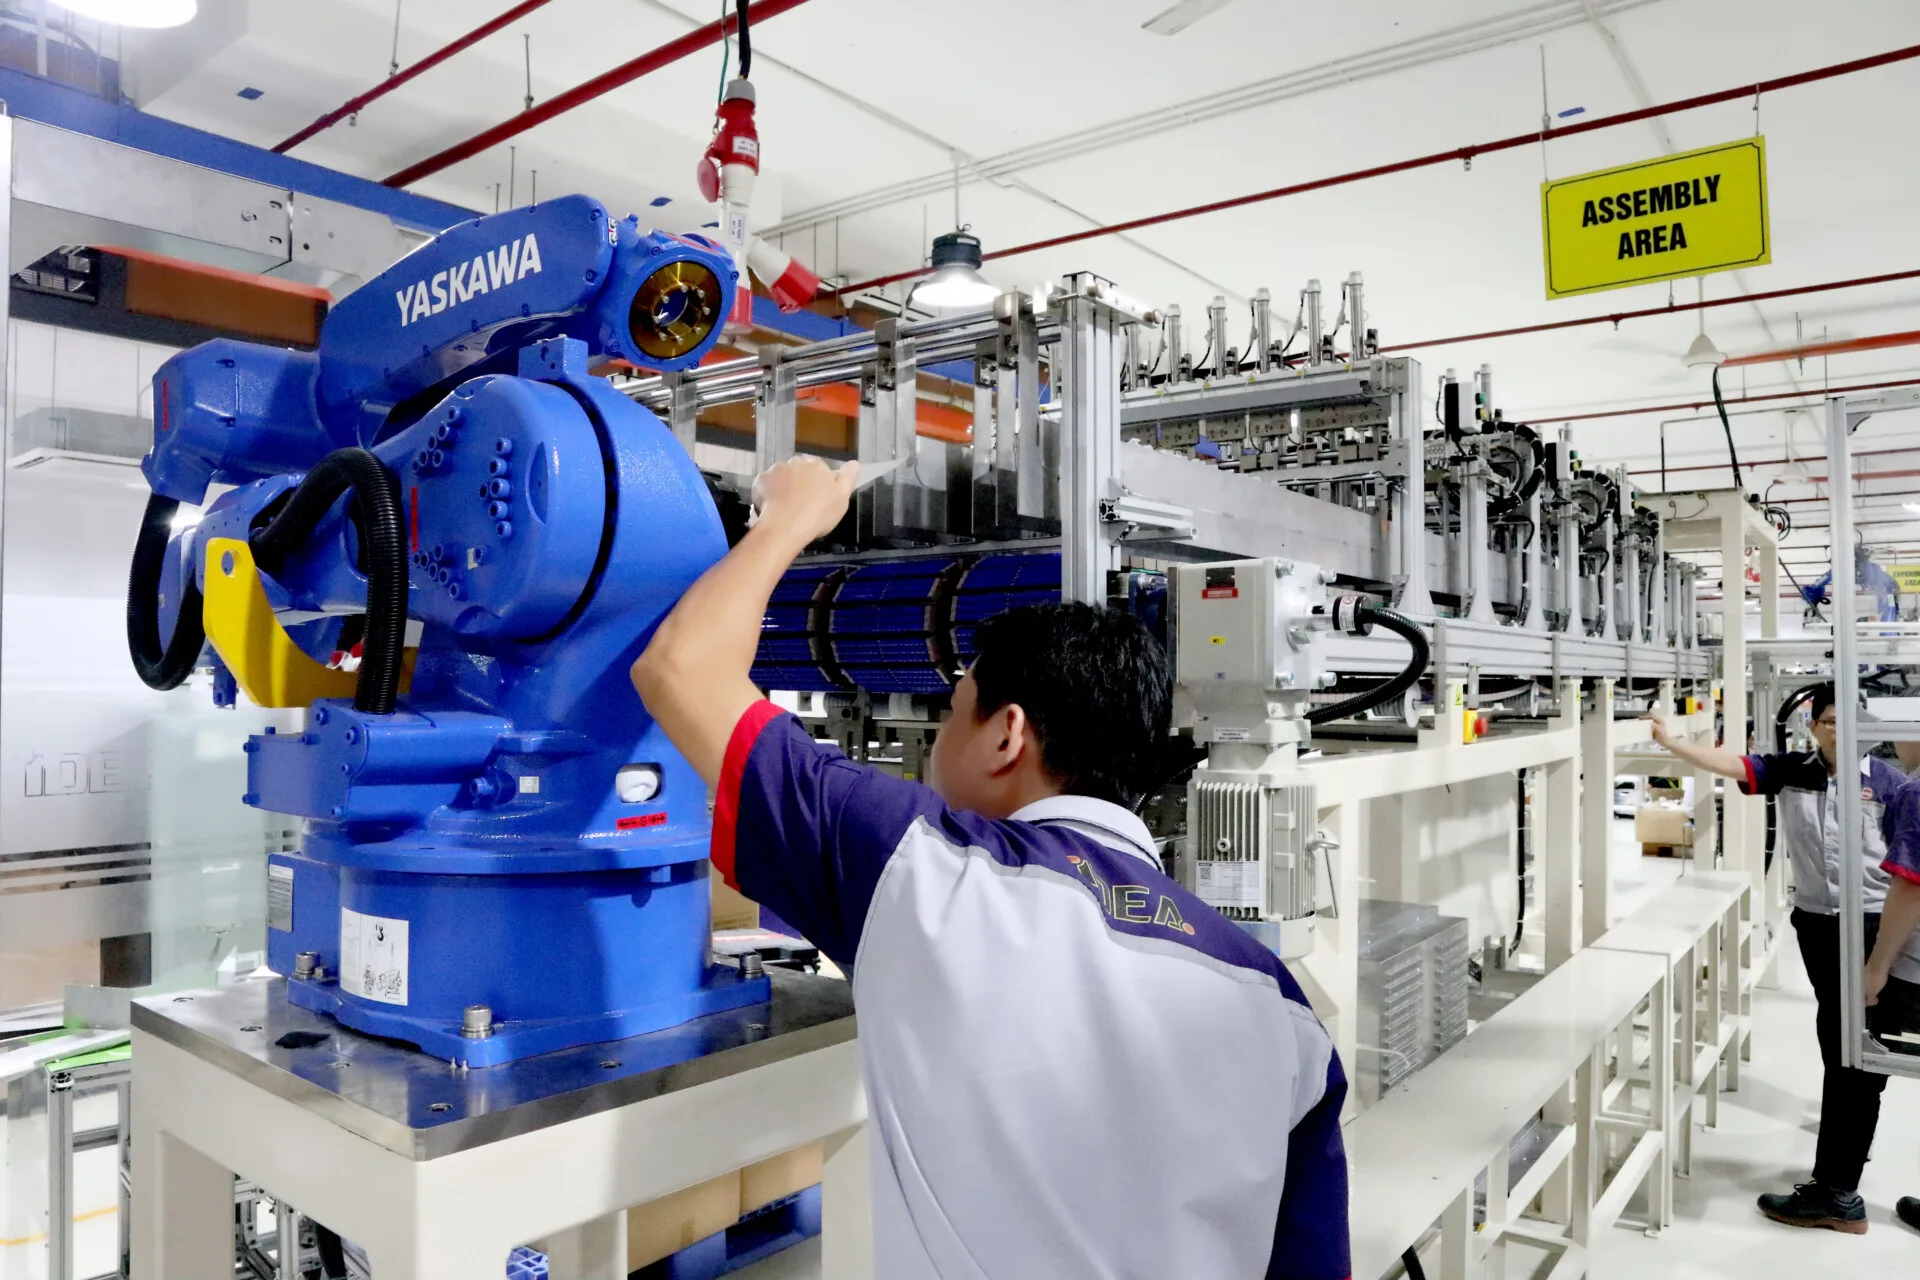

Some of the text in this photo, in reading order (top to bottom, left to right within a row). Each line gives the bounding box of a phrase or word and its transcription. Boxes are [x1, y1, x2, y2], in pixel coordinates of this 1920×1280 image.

[1582, 174, 1721, 228] ASSEMBLY
[1618, 222, 1687, 260] AREA
[395, 233, 542, 327] YASKAWA
